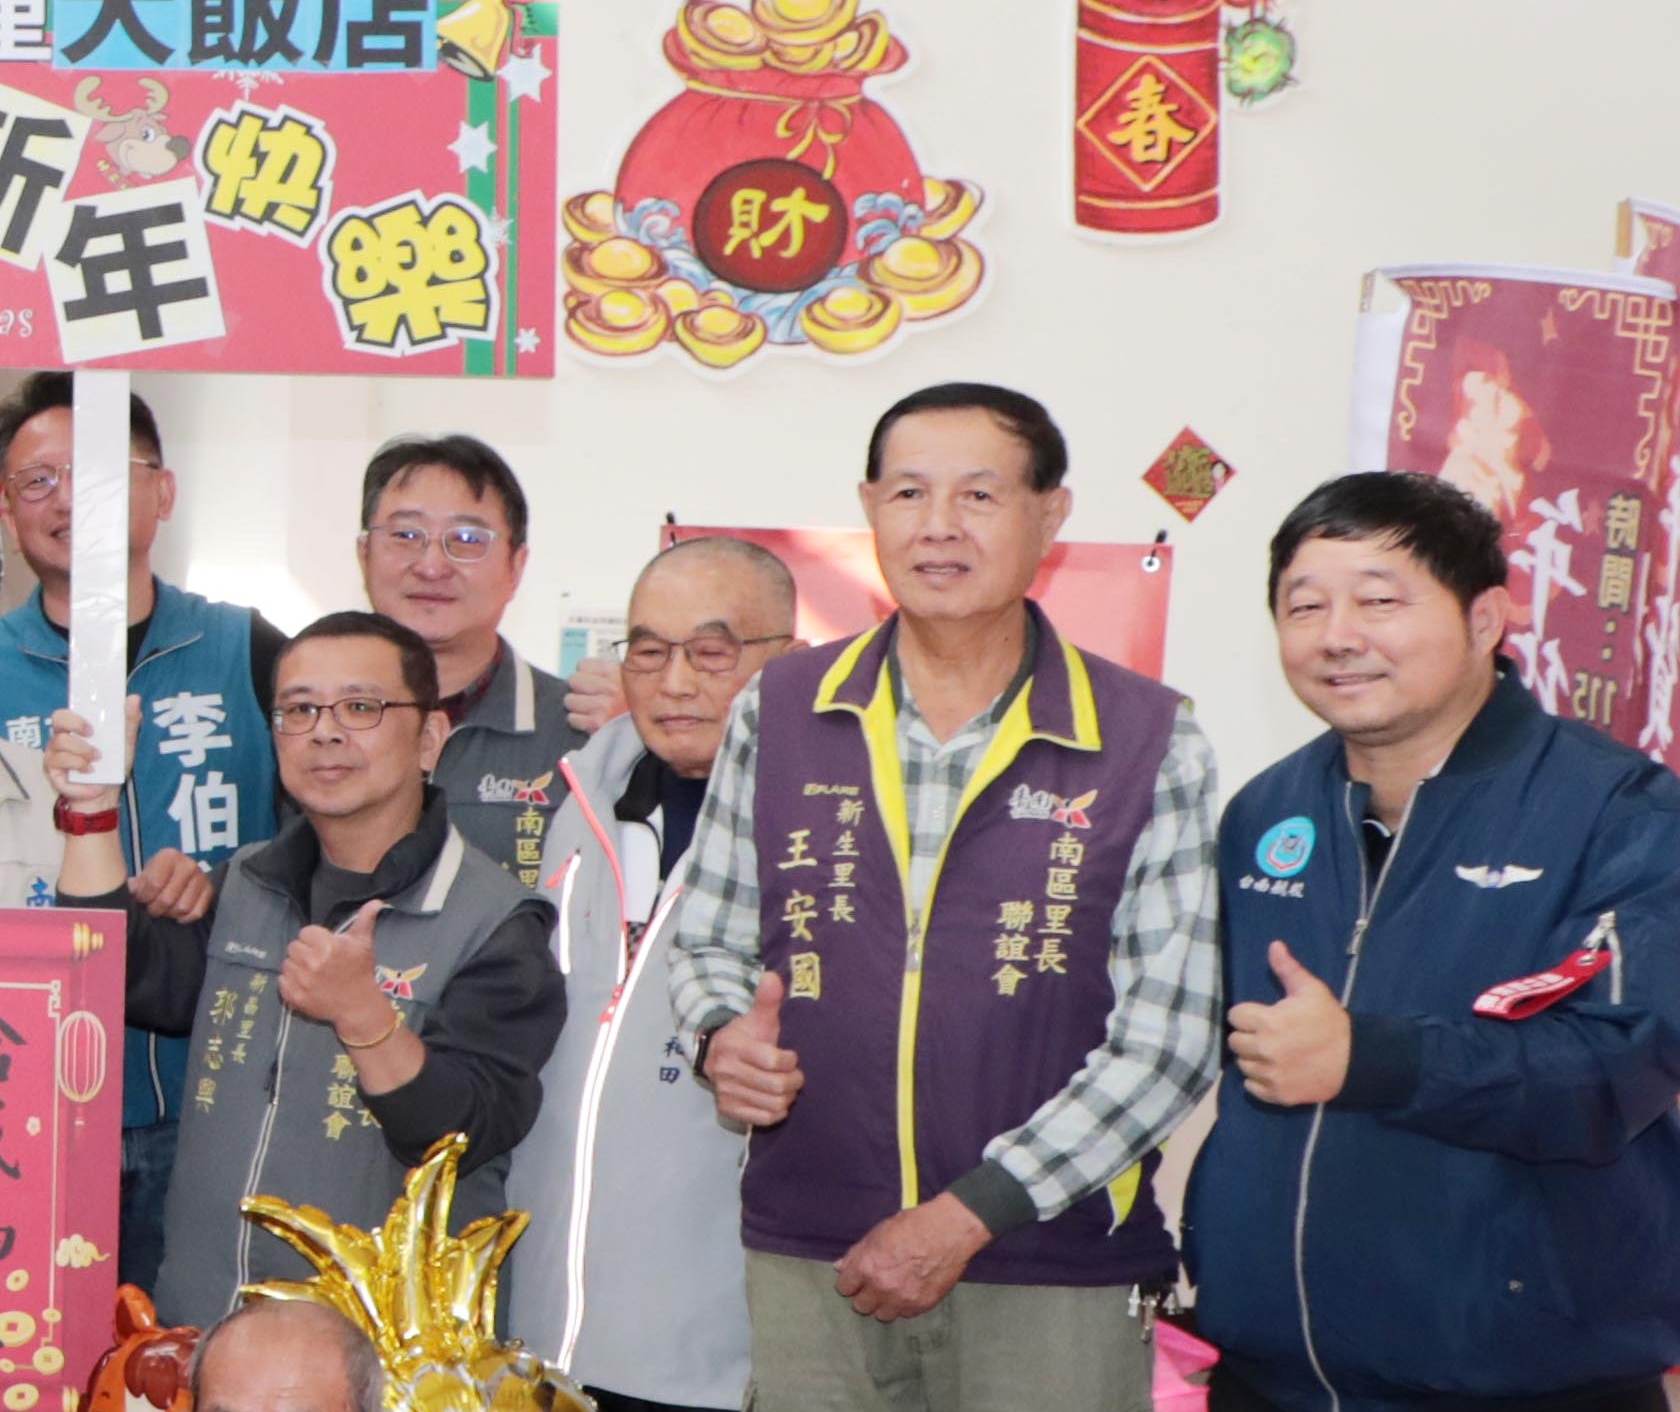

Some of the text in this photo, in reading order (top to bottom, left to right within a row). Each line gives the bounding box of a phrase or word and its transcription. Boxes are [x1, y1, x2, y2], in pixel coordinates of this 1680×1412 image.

[1110, 75, 1197, 166] 春
[723, 185, 831, 260] 財
[152, 691, 239, 873] 李伯
[777, 829, 822, 1002] 王安國
[827, 798, 865, 924] 新生里長
[1033, 831, 1085, 975] 南區里長
[991, 899, 1035, 997] 聯誼會
